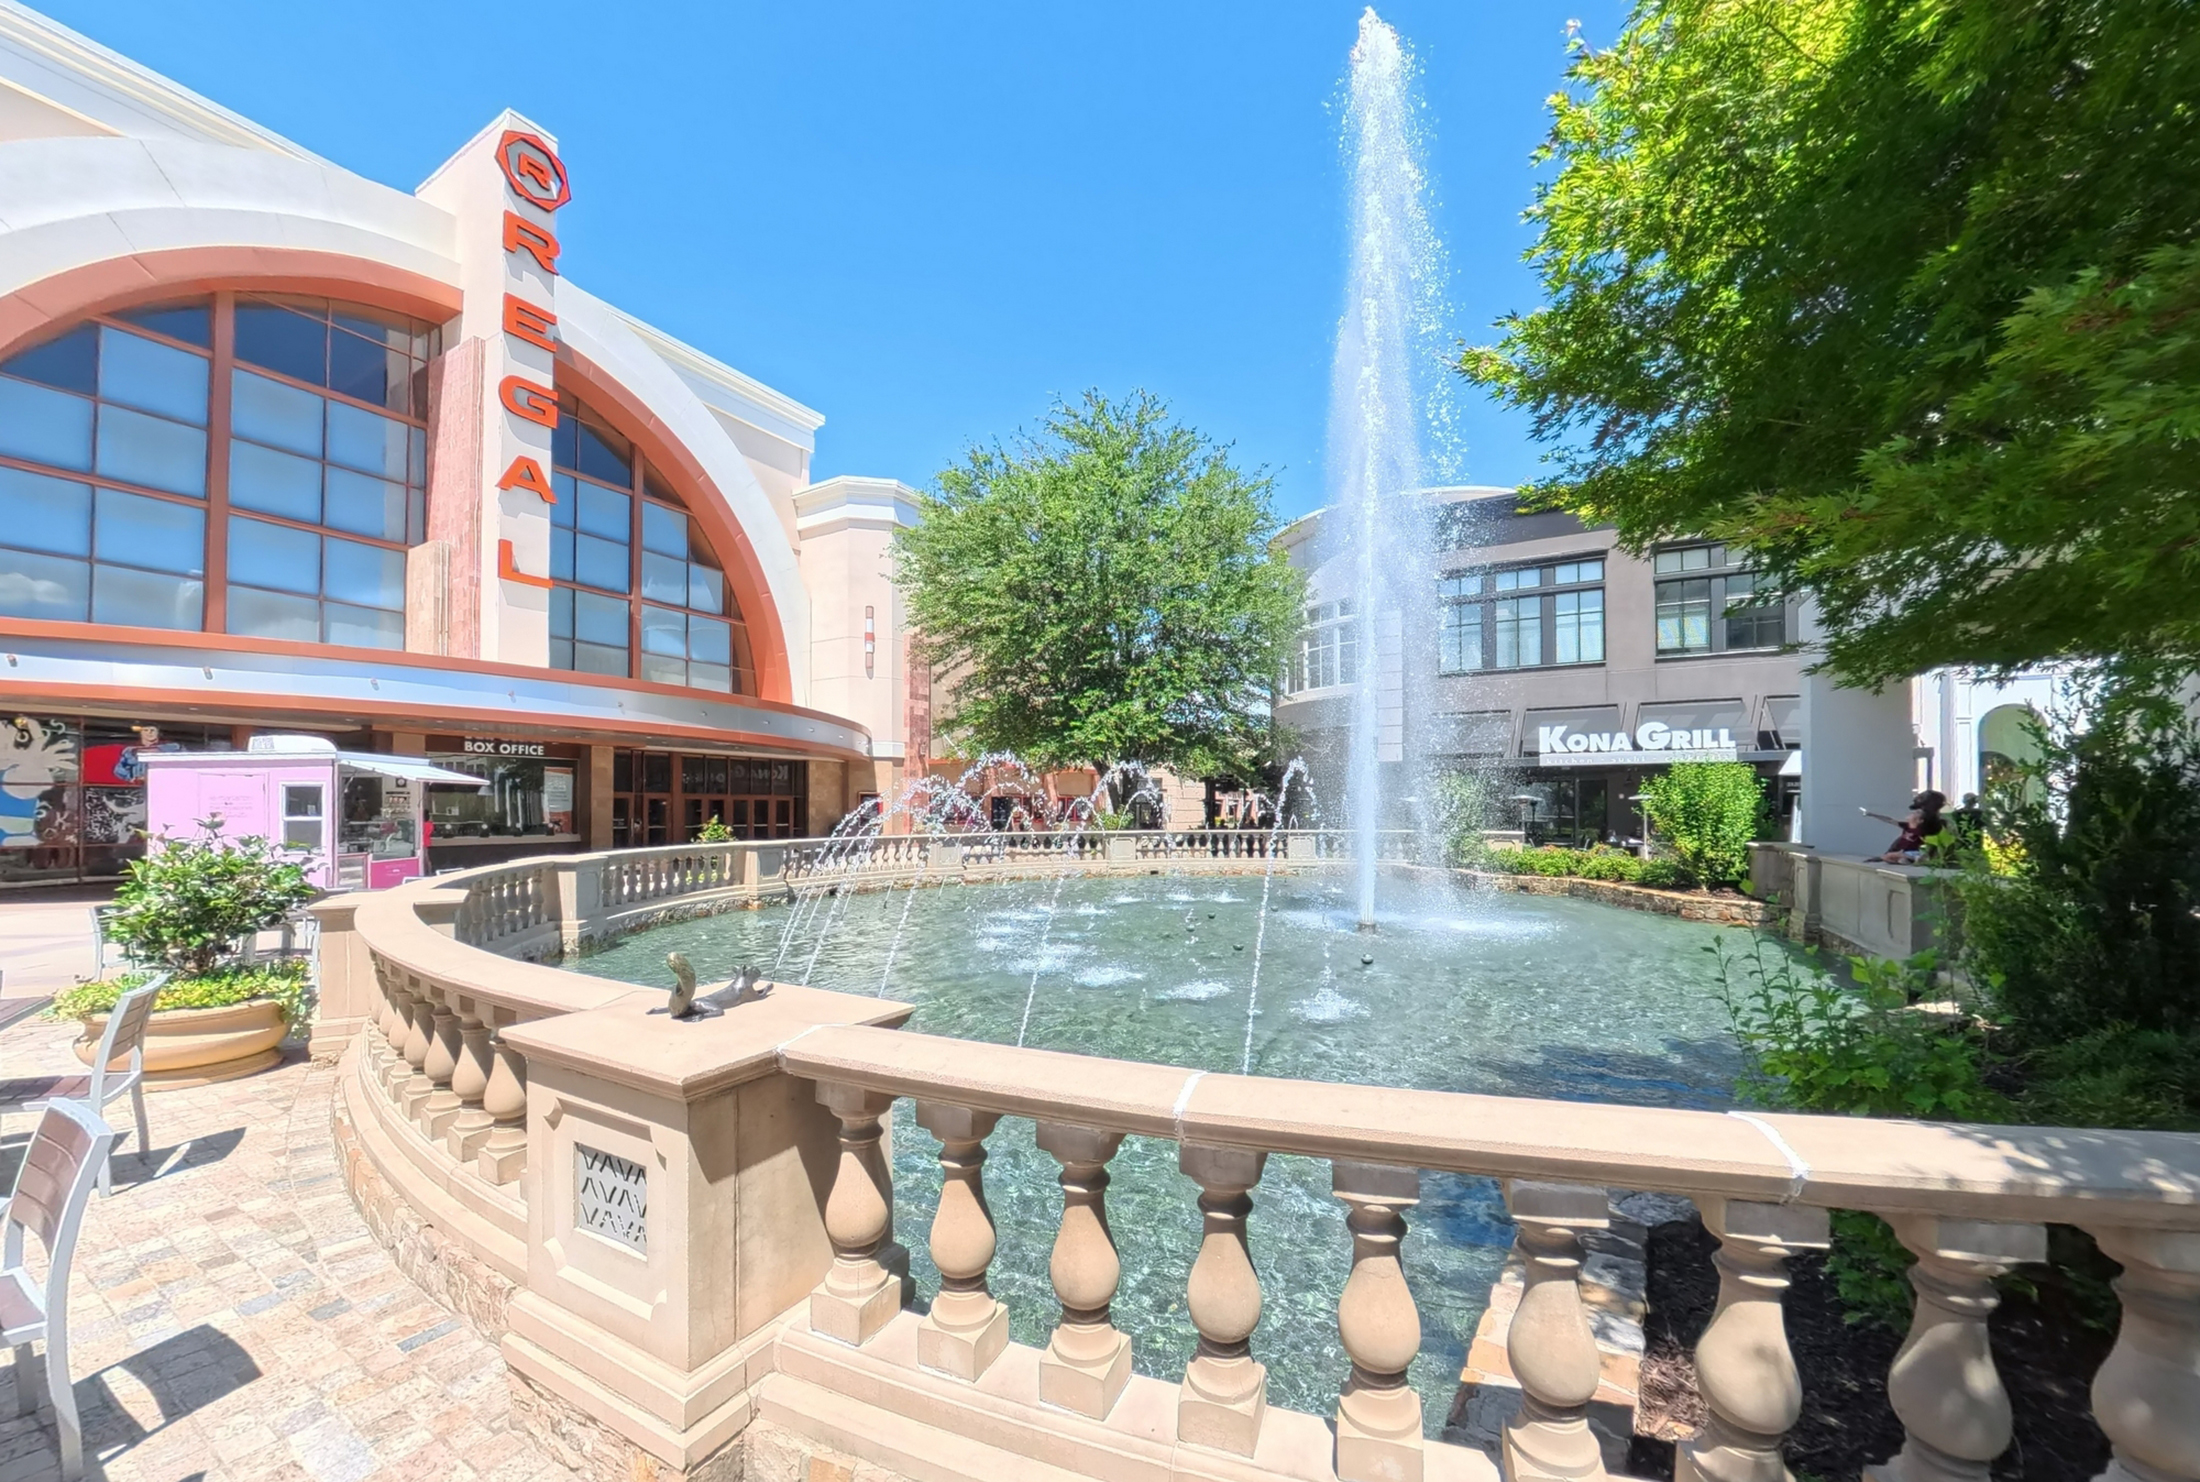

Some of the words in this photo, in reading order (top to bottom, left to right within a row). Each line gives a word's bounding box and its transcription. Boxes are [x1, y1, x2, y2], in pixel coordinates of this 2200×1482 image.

[517, 151, 553, 191] R
[496, 208, 561, 588] REGAL
[464, 741, 495, 753] BOX
[499, 743, 545, 755] OFFICE
[1539, 725, 1633, 753] KONA
[1636, 721, 1736, 750] GRILL
[1610, 755, 1646, 763] sushi
